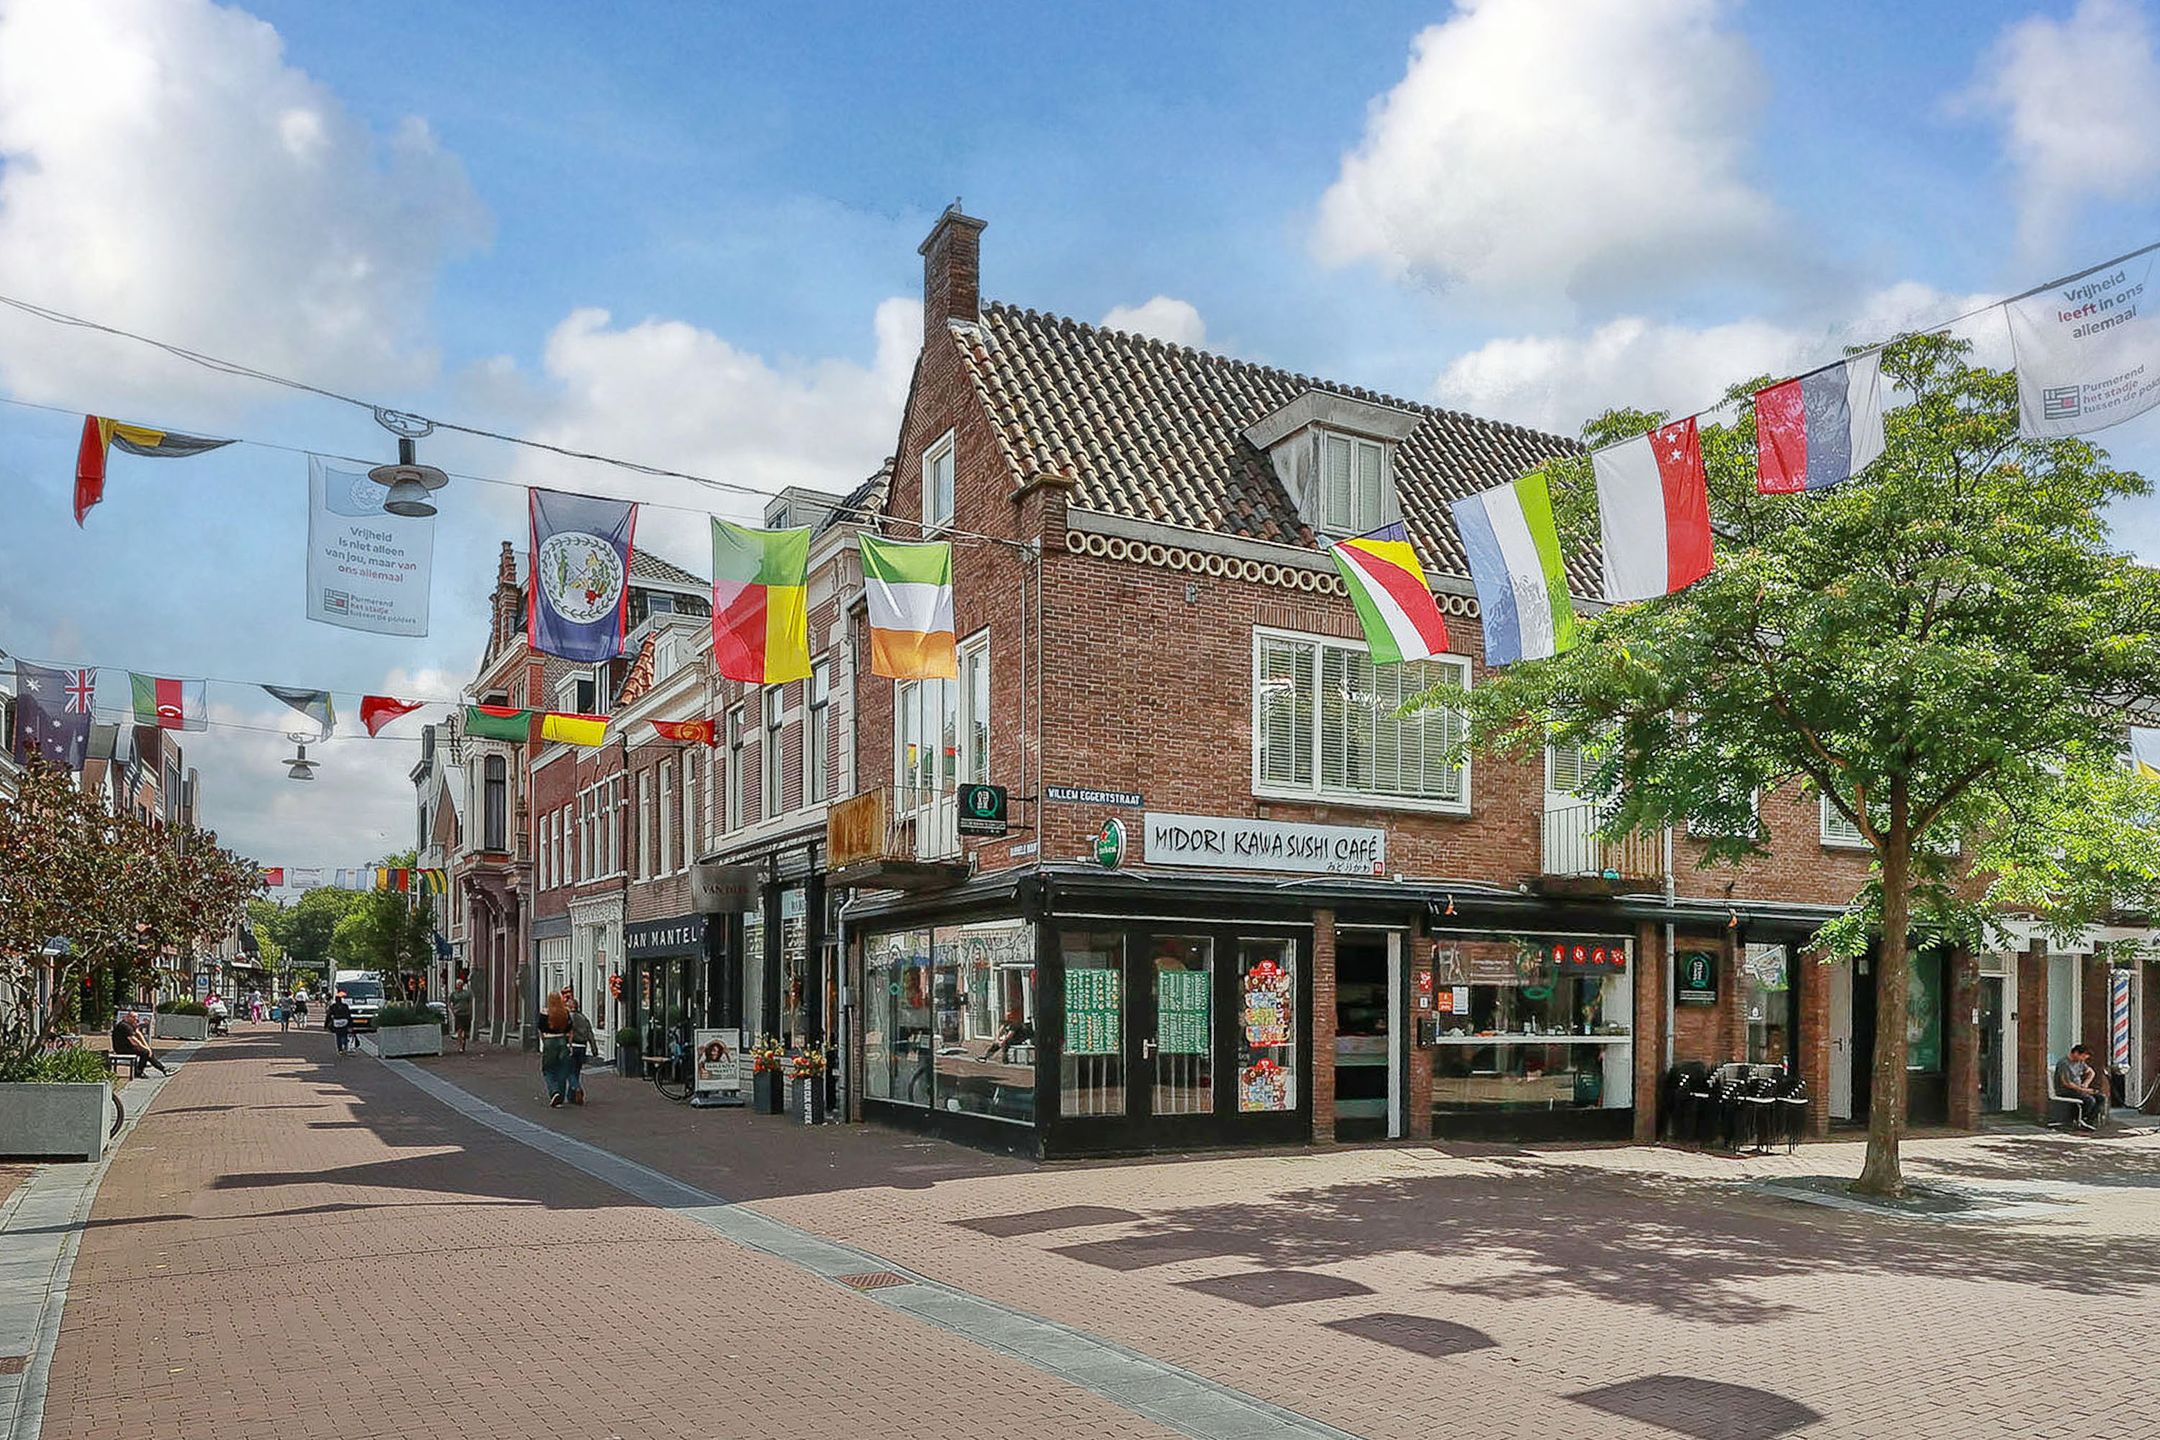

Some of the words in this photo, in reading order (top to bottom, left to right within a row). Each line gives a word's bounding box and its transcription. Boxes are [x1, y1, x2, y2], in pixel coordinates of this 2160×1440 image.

[2063, 270, 2126, 301] Vrijheid
[2058, 303, 2097, 322] leeft
[2099, 298, 2114, 311] in
[2116, 283, 2143, 304] ons
[2072, 304, 2137, 339] allemaal
[2083, 364, 2145, 392] Purmerend
[2083, 393, 2102, 404] het
[2104, 380, 2139, 399] stadje
[2084, 398, 2121, 413] tussen
[350, 526, 392, 542] Vrijheid
[325, 547, 345, 559] van
[346, 552, 366, 565] jou,
[368, 558, 396, 568] maar
[349, 541, 371, 551] niet
[373, 545, 405, 557] alleen
[338, 565, 358, 574] ons
[360, 568, 403, 583] allemaal
[1048, 788, 1078, 799] WILLEM
[1080, 790, 1140, 805] EGGERTSTRAAT
[1155, 826, 1225, 853] MIDORI
[1234, 831, 1283, 858] KAWA
[1288, 834, 1329, 859] SUSHI
[1334, 836, 1378, 861] CAFÉ
[702, 885, 722, 895] VAN
[628, 933, 647, 949] JAN
[651, 926, 697, 947] MANTEL
